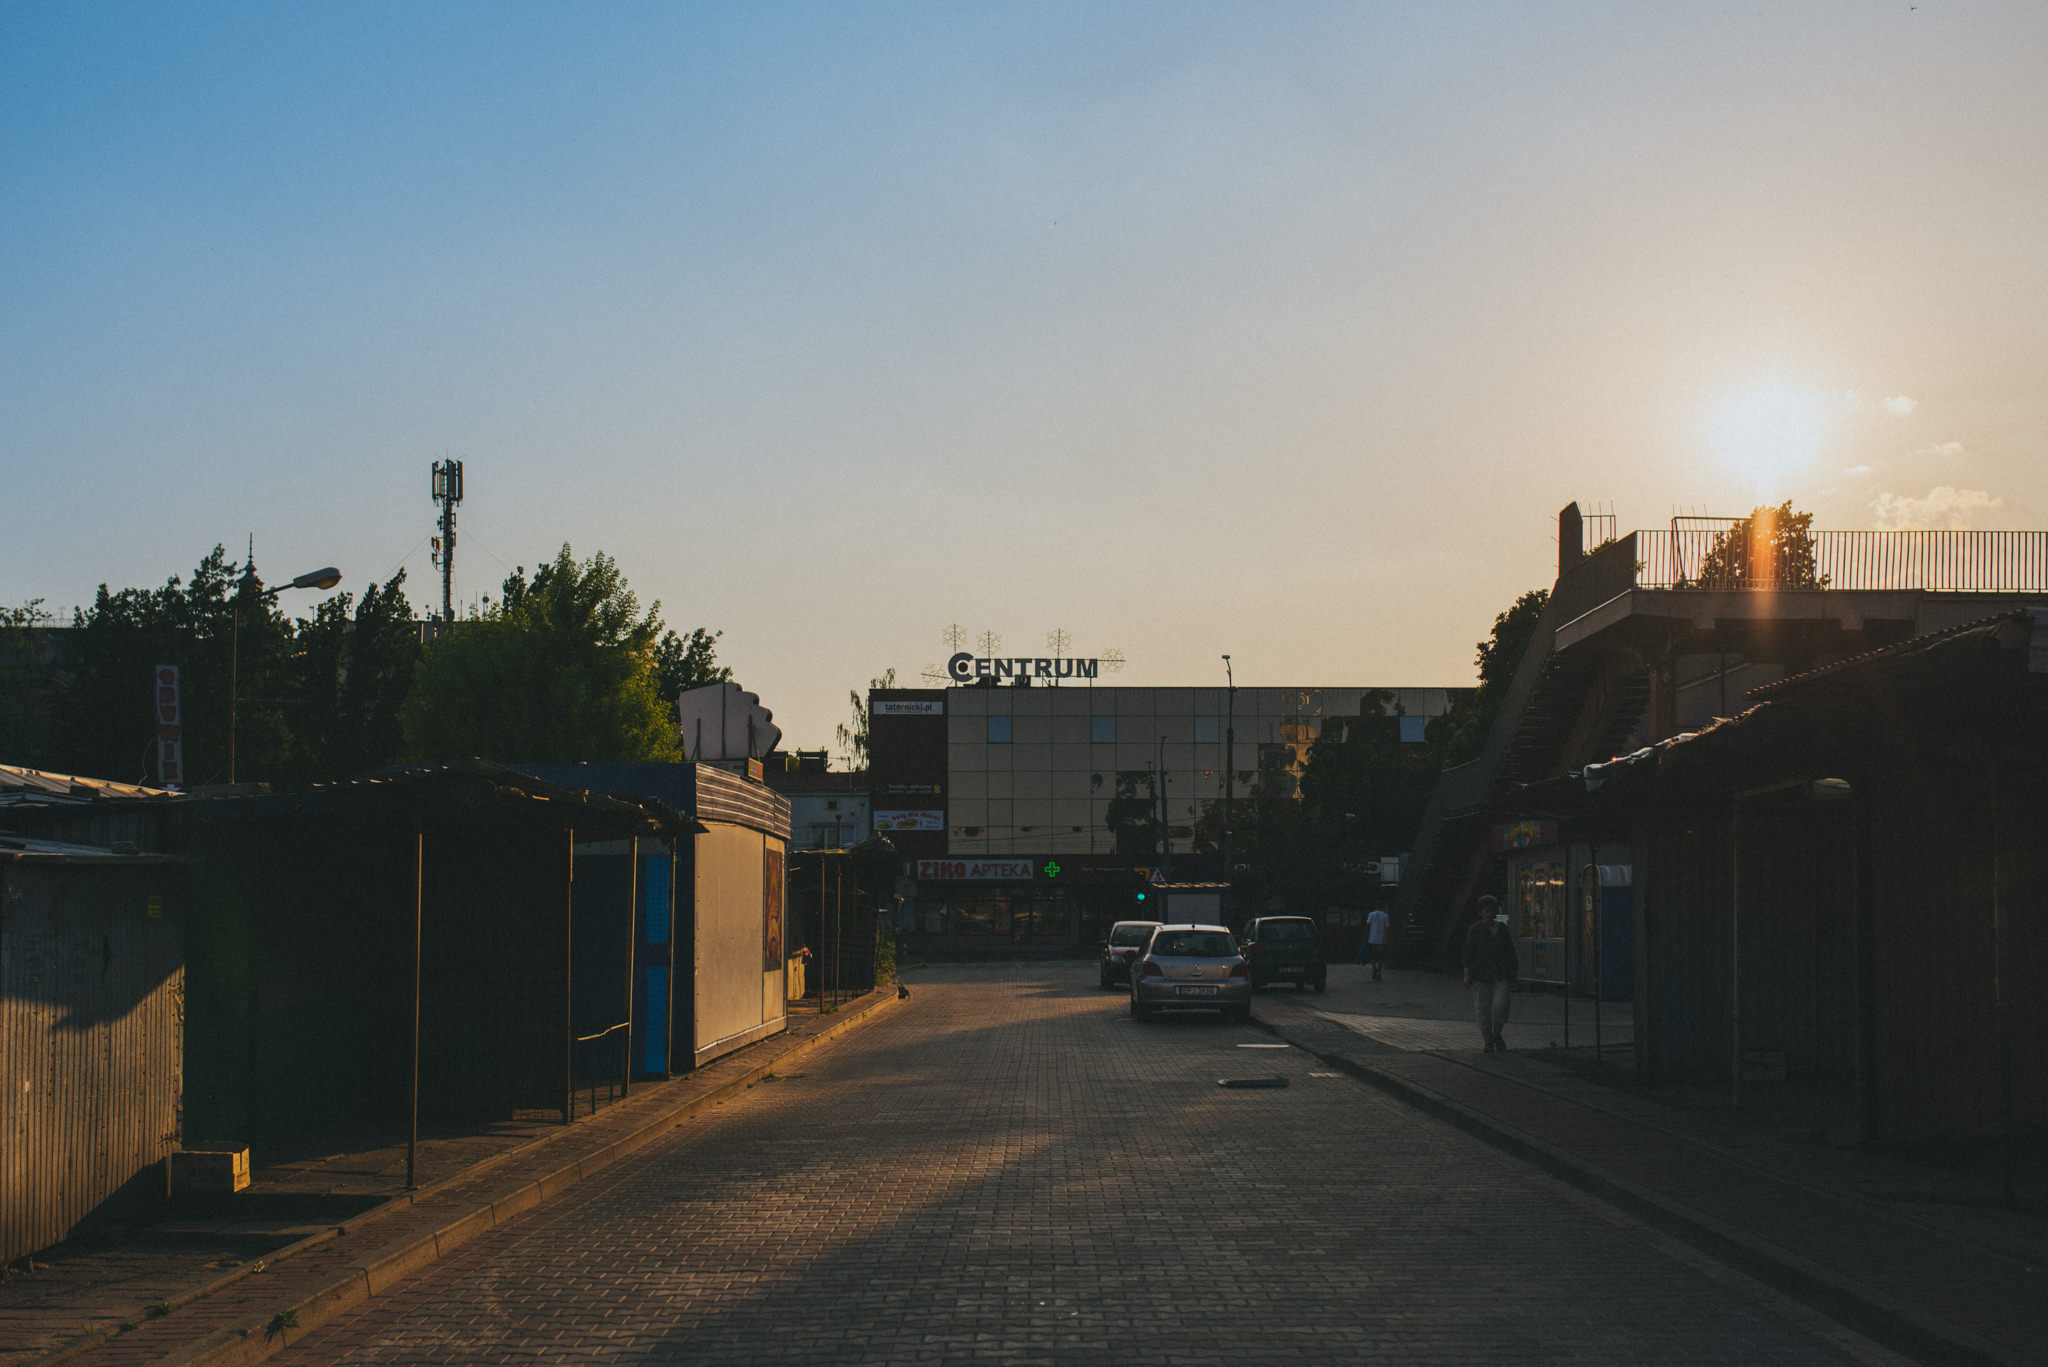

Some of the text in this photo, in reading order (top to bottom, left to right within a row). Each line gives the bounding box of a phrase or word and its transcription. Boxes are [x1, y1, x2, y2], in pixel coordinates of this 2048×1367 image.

[948, 652, 1098, 682] CENTRUM
[885, 703, 933, 712] taternicki.pl
[971, 863, 1032, 877] APTEKA
